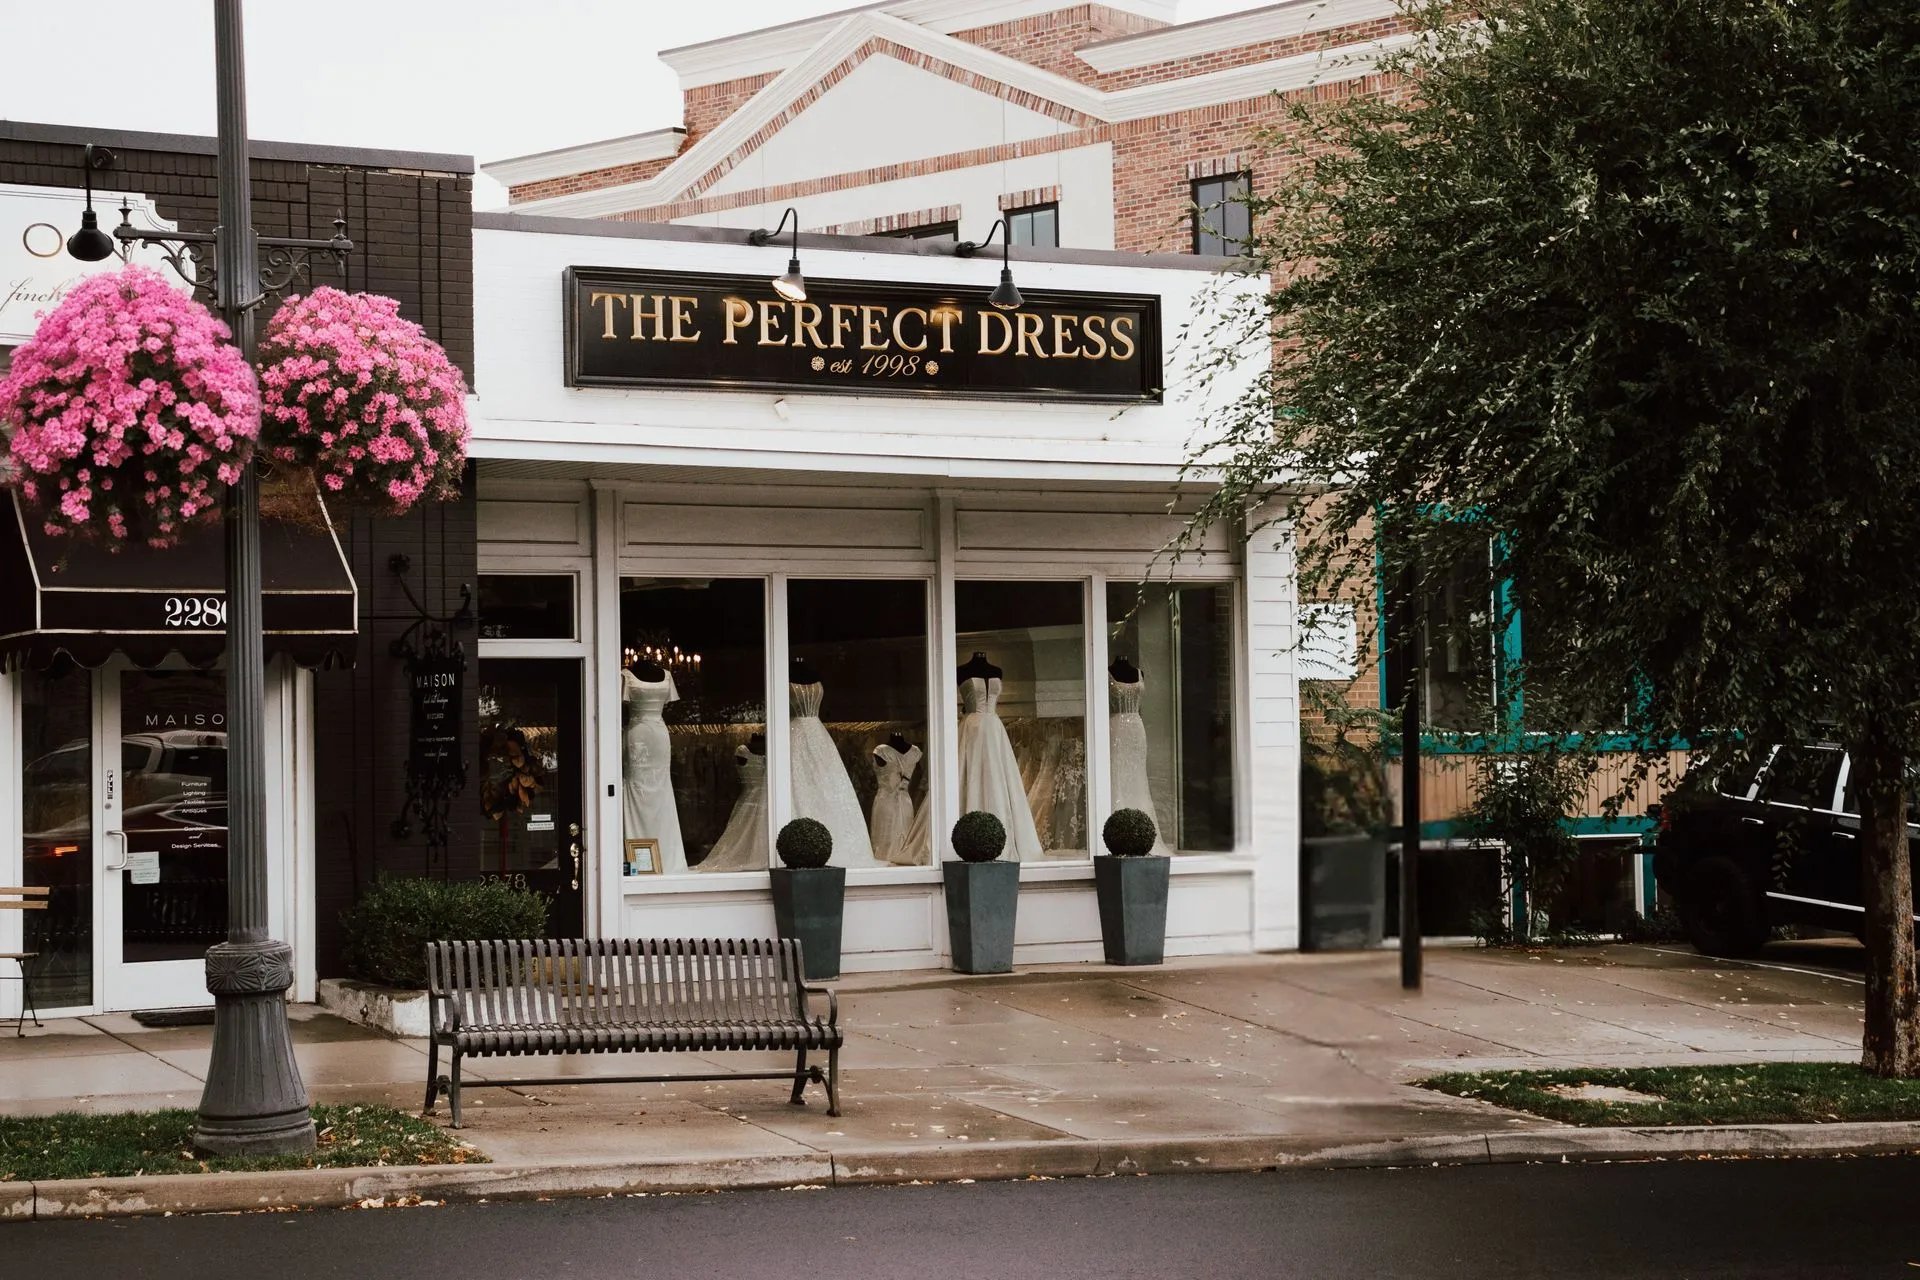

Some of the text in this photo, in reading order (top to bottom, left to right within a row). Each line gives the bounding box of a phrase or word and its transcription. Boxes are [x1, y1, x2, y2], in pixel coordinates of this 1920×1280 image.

[591, 292, 1136, 360] THE PERFECT DRESS
[830, 354, 920, 377] est 1998
[145, 713, 225, 726] MAISO
